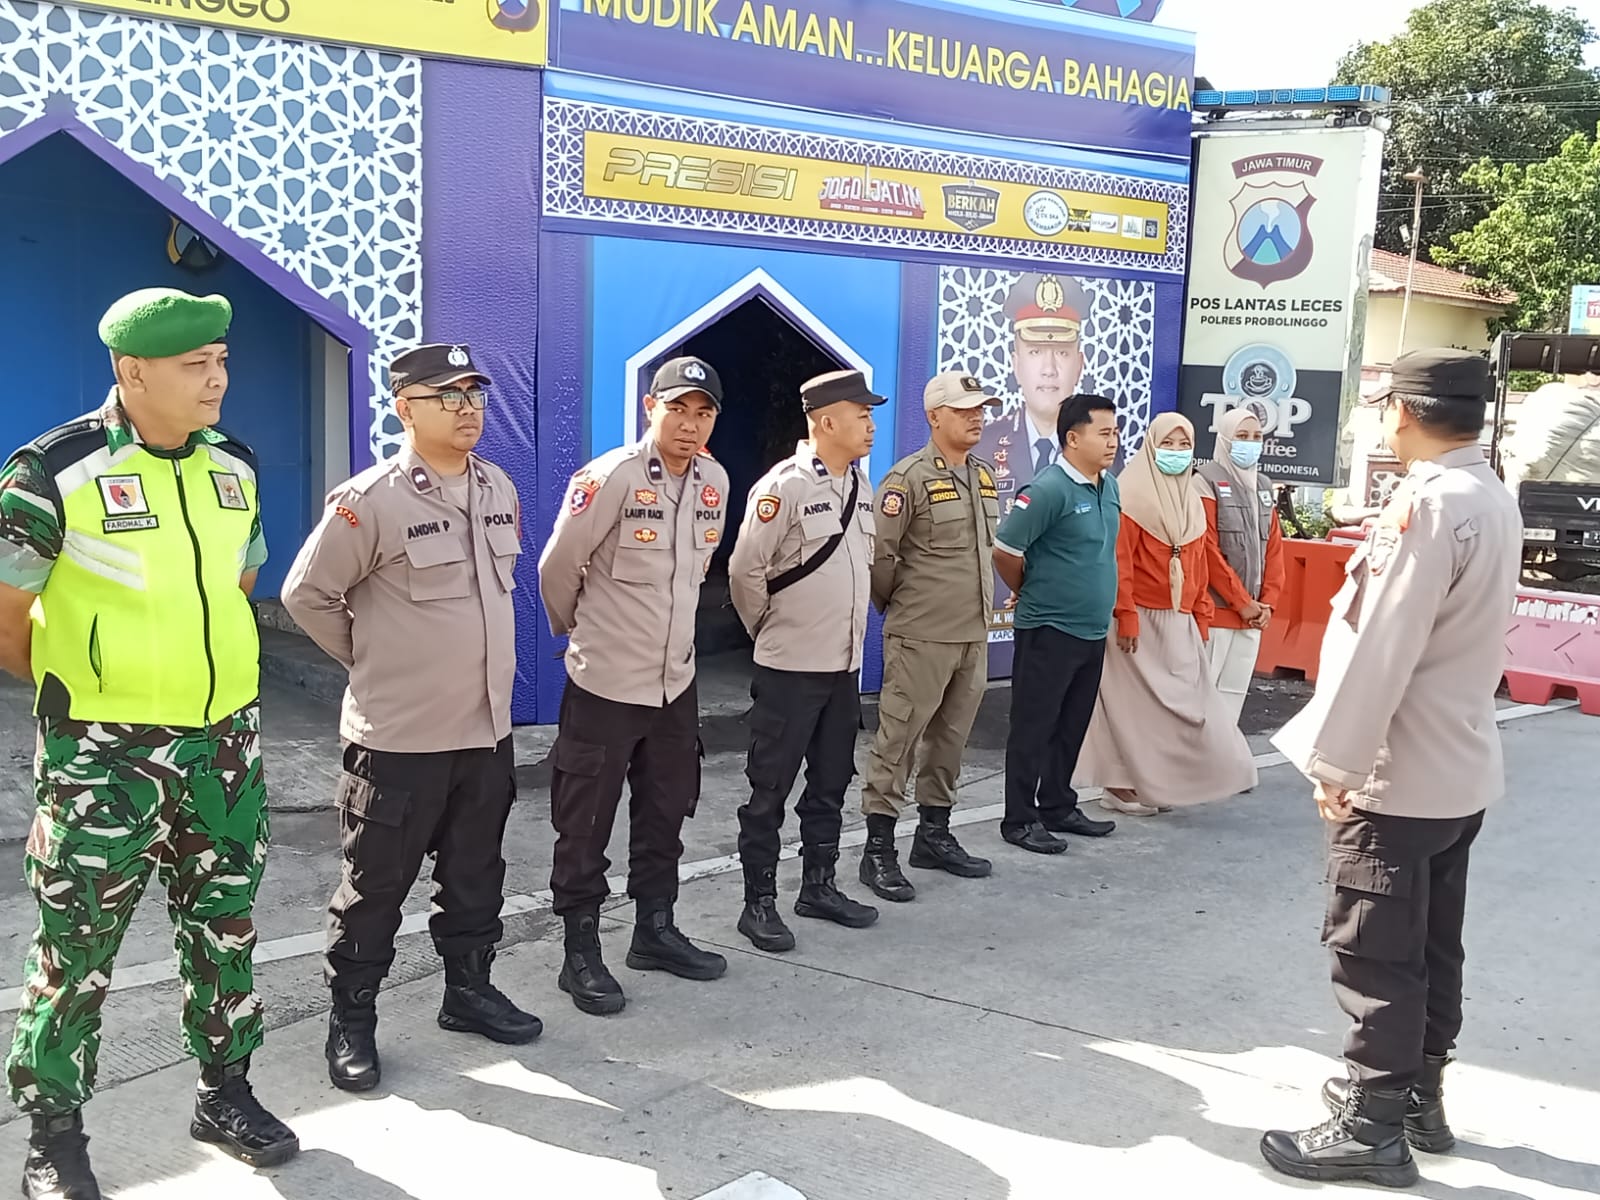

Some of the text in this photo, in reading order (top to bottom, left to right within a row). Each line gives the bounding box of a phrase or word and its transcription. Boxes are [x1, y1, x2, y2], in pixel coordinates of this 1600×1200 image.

[1064, 59, 1192, 113] BAHAGIA
[1242, 157, 1313, 172] JAWA TIMUR
[603, 147, 799, 201] PRESISI
[947, 193, 996, 213] BERKAH
[1190, 298, 1343, 312] POS LANTAS LECES
[1200, 316, 1328, 327] POLRES PROBOLINGGO
[1200, 393, 1313, 438] TOP
[1264, 463, 1319, 476] INDONESIA
[803, 501, 832, 516] ANDIK
[407, 520, 450, 539] ANDHI P
